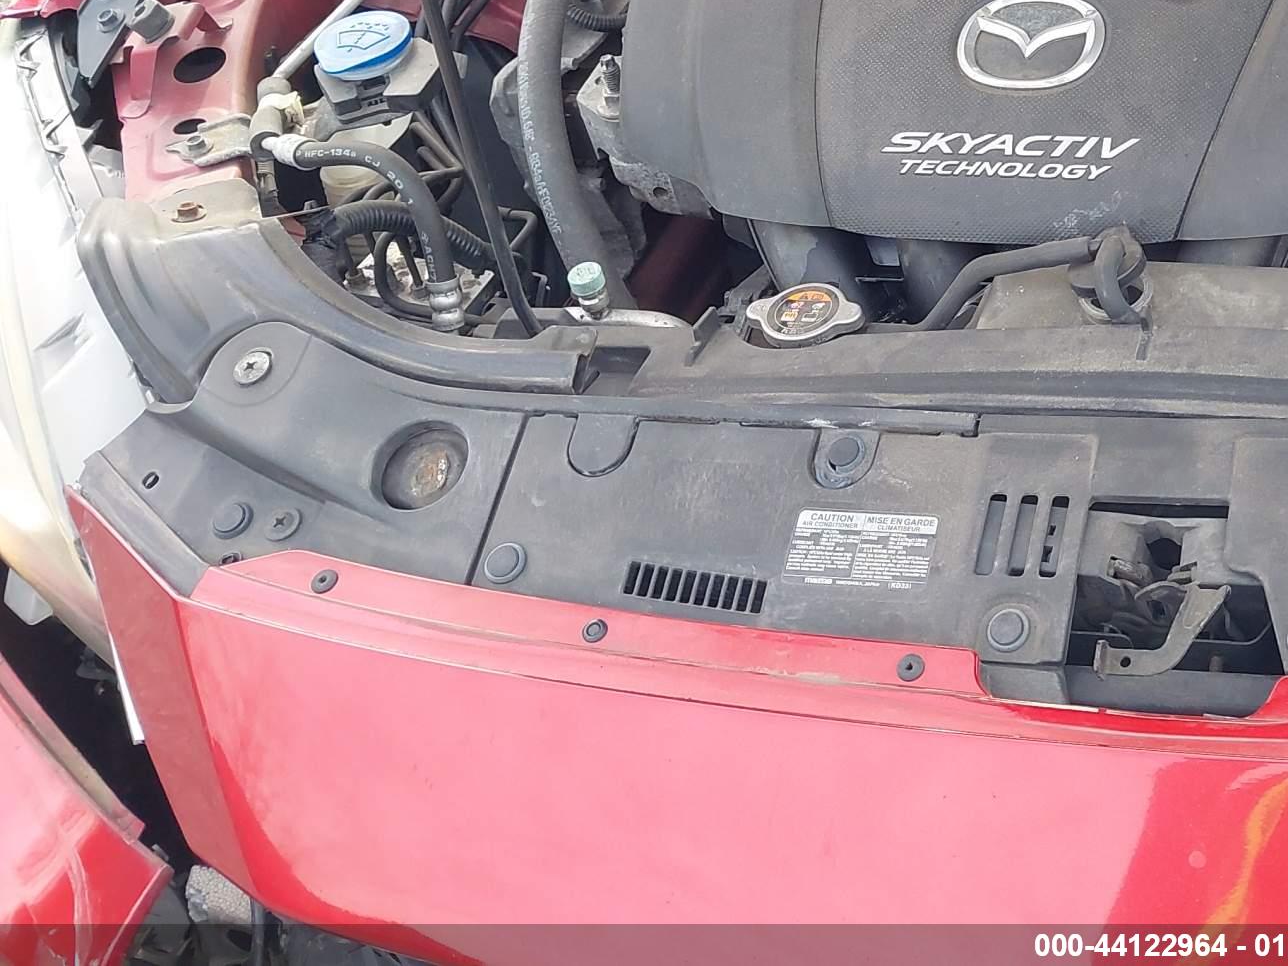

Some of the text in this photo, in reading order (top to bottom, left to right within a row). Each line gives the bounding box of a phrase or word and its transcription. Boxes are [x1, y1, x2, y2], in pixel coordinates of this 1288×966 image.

[881, 131, 1141, 159] SKYACTIV
[900, 159, 1112, 180] TECHNOLOGY
[810, 513, 855, 523] CAUTION
[867, 516, 936, 527] MISE EN GARDE
